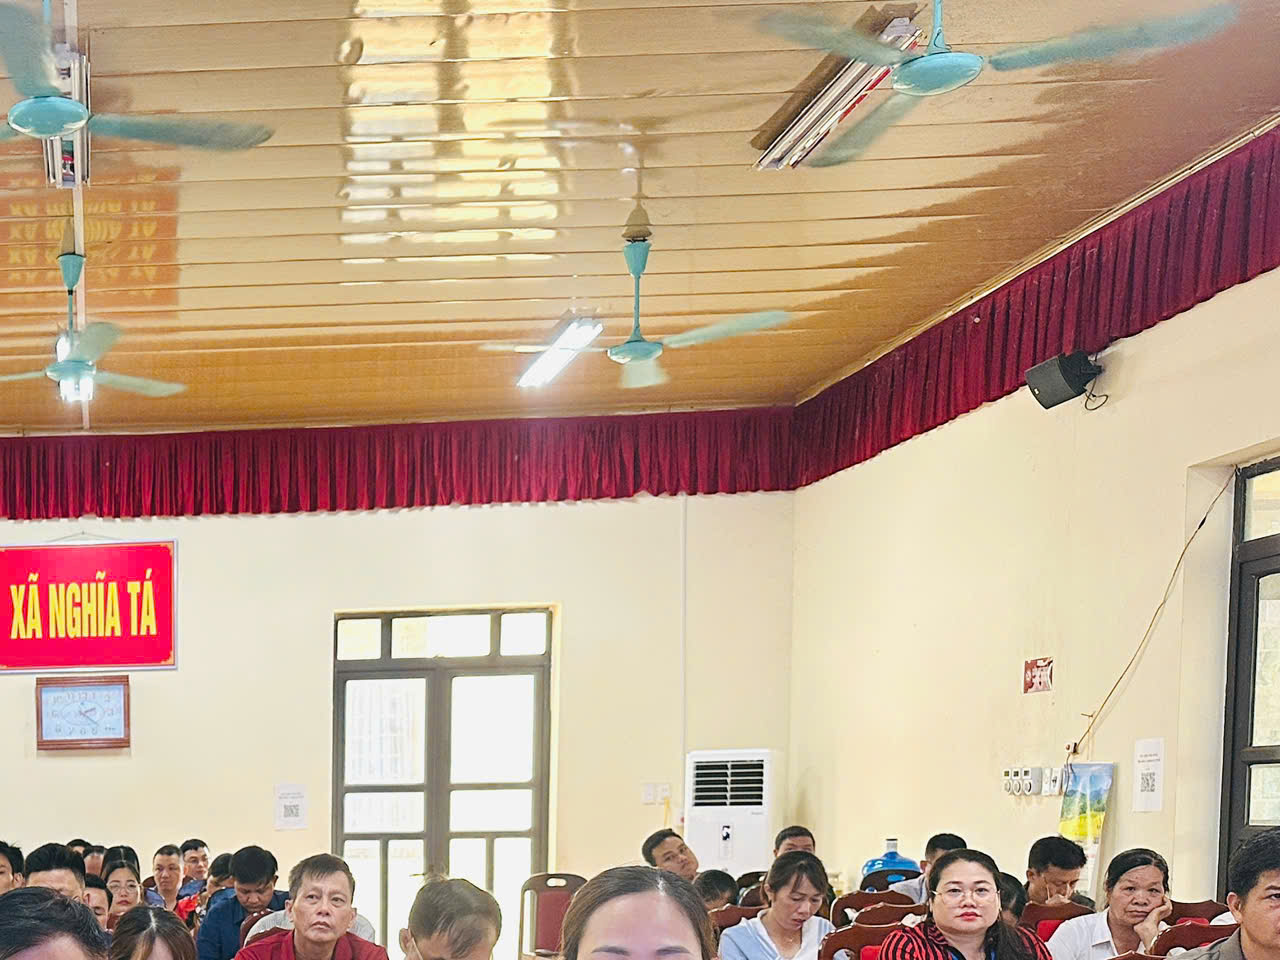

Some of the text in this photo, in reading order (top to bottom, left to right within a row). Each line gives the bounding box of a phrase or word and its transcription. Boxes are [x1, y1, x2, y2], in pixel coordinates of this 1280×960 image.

[10, 568, 157, 639] XÃ NGHĨA TÁ
